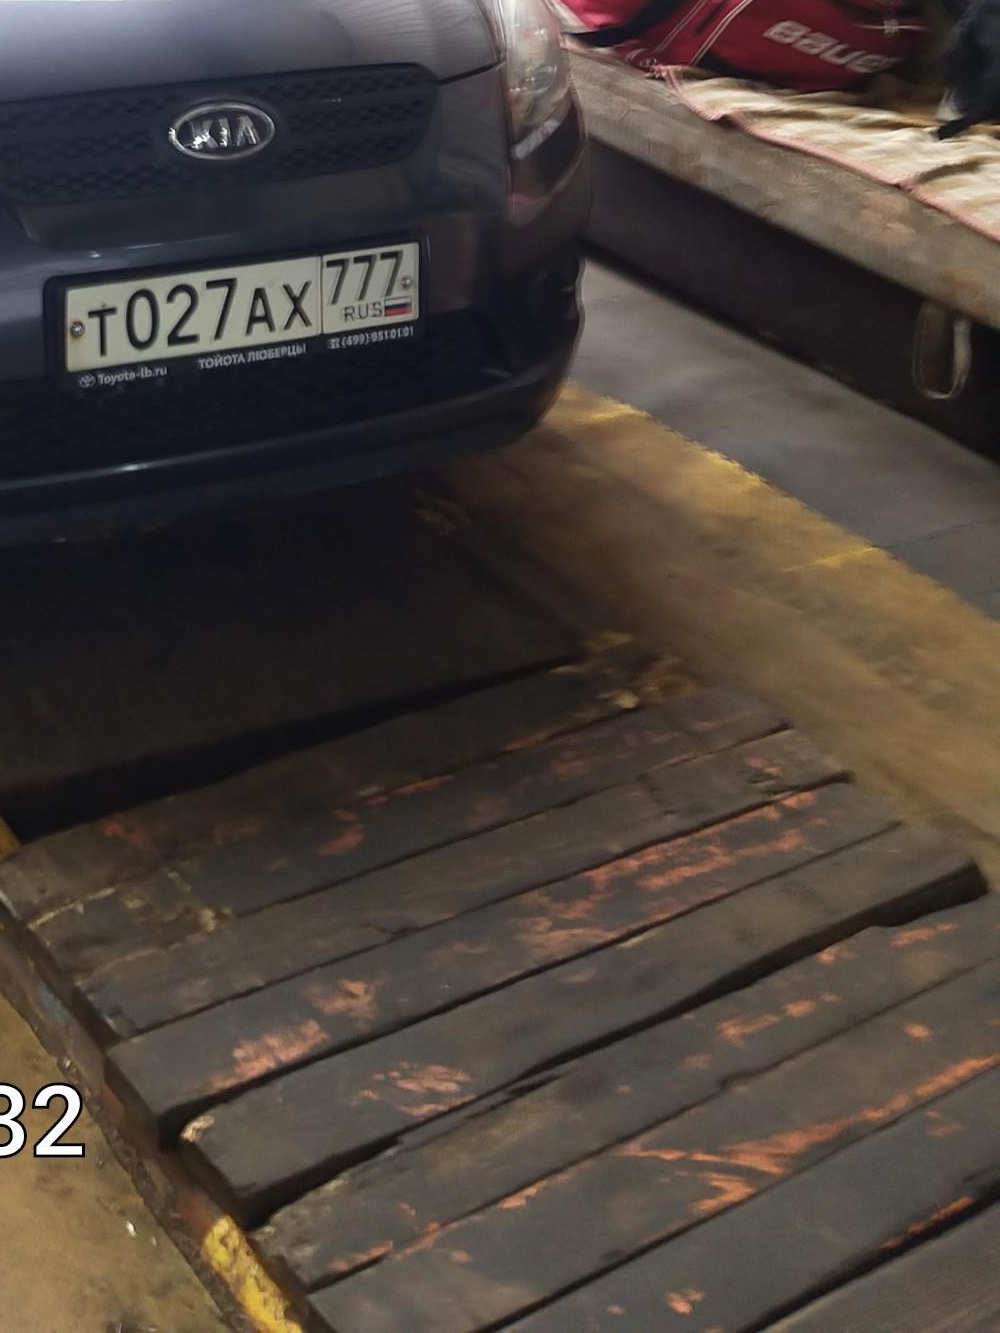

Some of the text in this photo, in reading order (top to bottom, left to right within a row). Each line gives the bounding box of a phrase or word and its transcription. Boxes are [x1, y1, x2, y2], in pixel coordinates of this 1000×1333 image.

[184, 114, 260, 149] KIA
[326, 250, 403, 306] 777
[344, 301, 382, 322] RUS
[199, 343, 306, 369] ТОЙОТА ЛЮБЕРЦЫ
